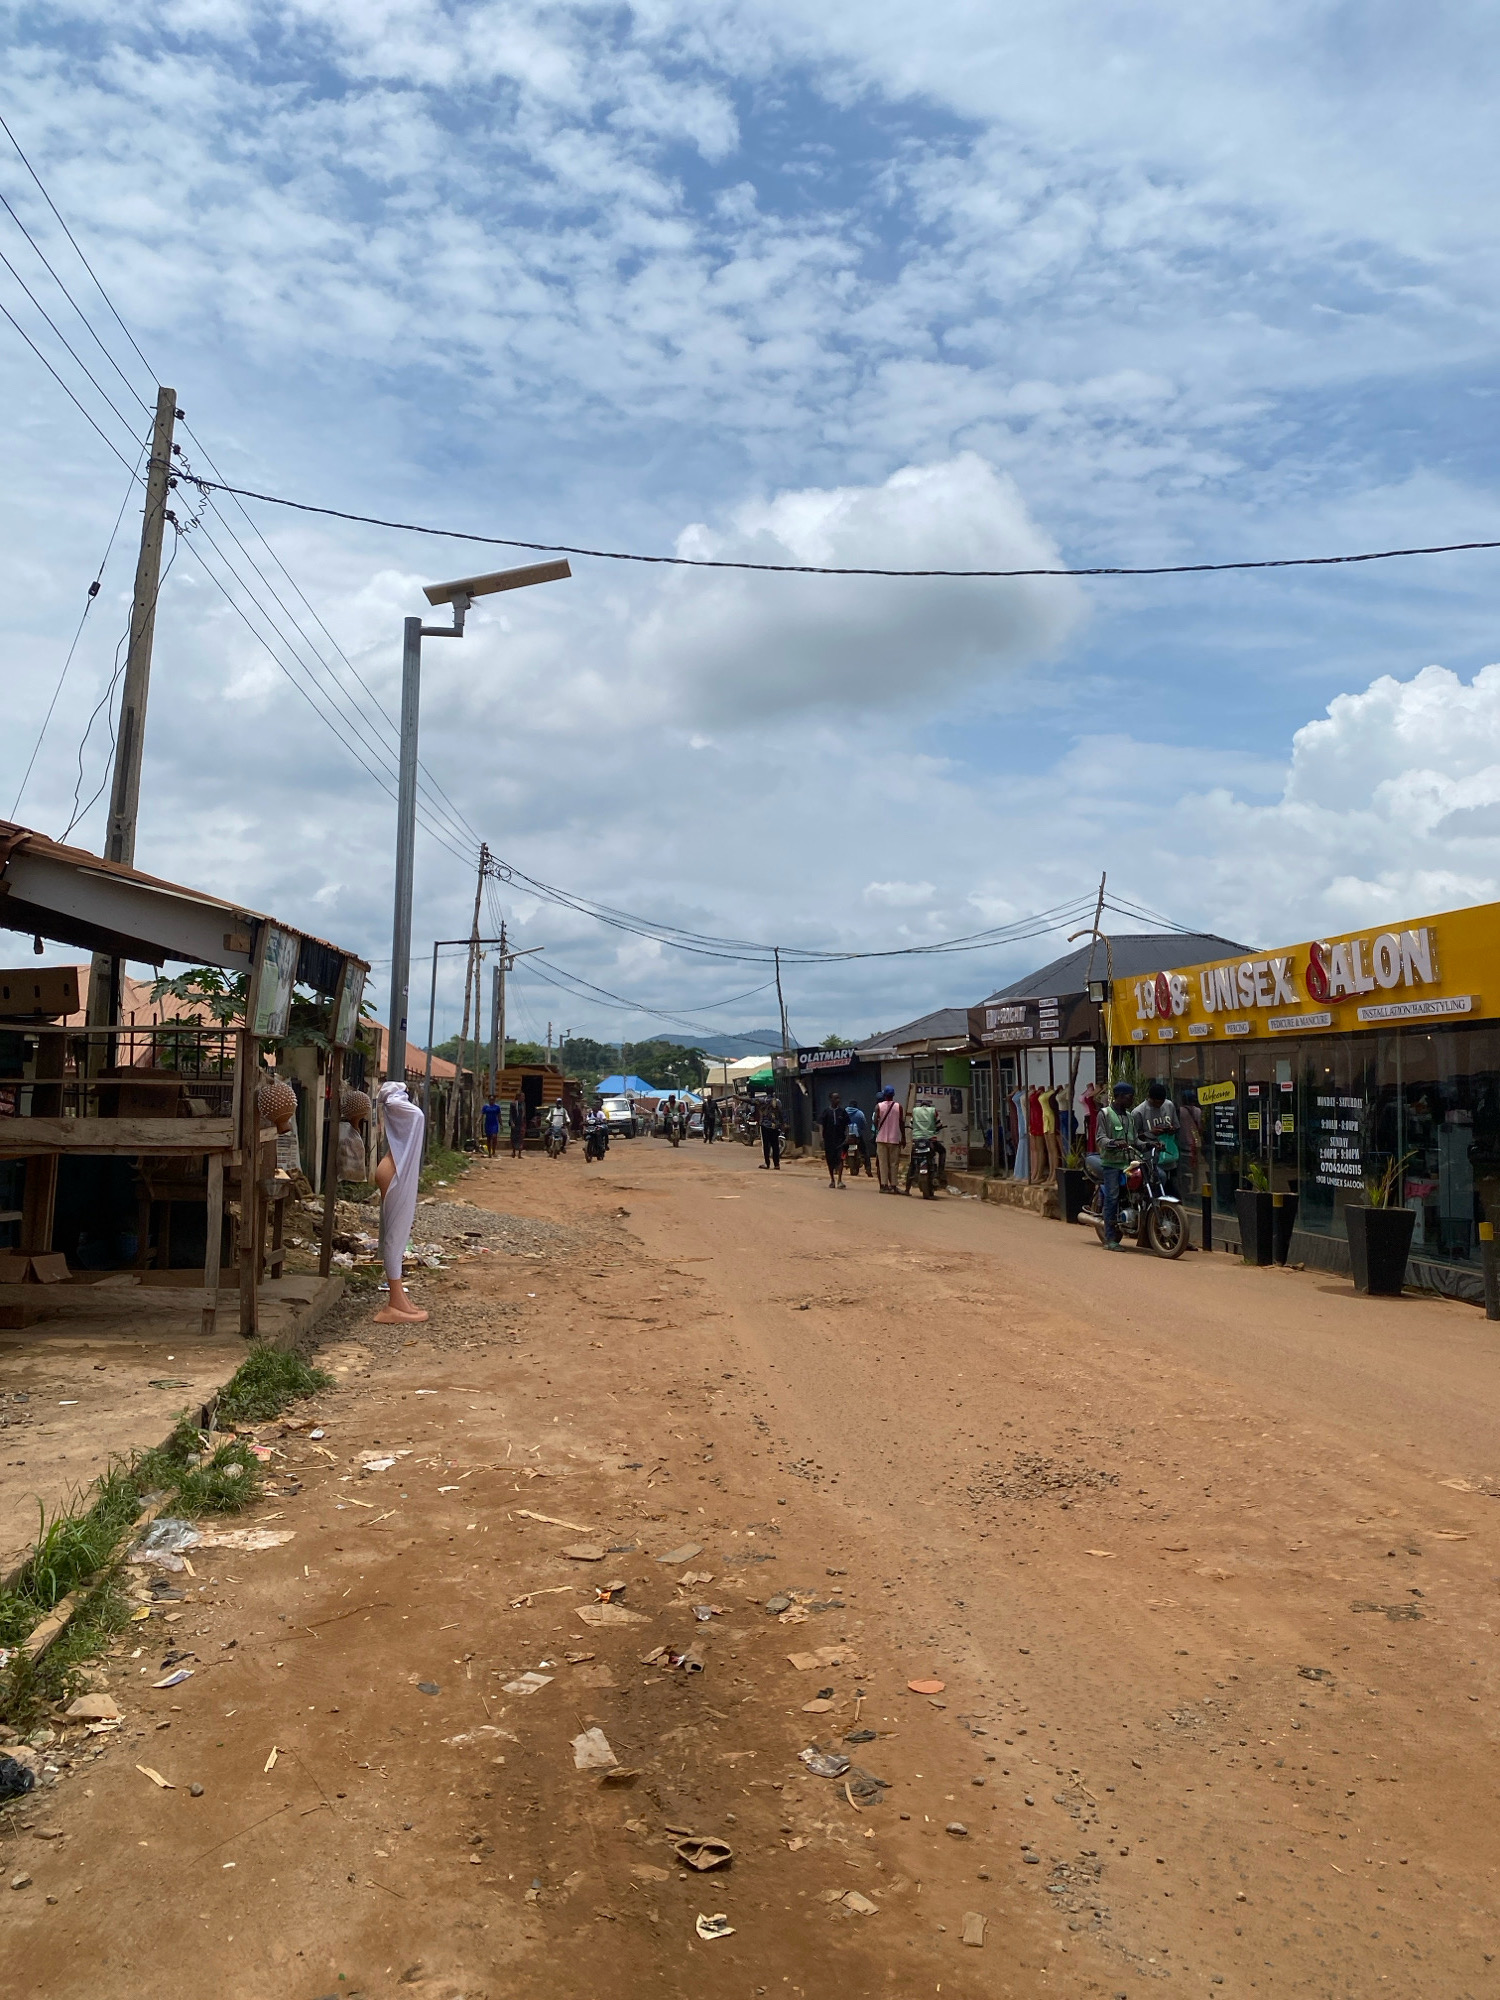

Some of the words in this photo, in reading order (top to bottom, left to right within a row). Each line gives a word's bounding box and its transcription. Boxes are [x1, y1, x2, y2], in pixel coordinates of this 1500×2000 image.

[1135, 971, 1187, 1020] 1908
[1200, 957, 1295, 1013] UNISEX
[1305, 928, 1434, 1005] SALON
[1227, 1024, 1247, 1034] PIERCING
[1271, 1019, 1294, 1030] PEDICURE
[1300, 1015, 1329, 1026] MANICURE
[800, 1048, 854, 1064] OLATMARY
[1203, 1088, 1231, 1102] Welcome
[1317, 1096, 1335, 1107] MONDAY
[1339, 1097, 1363, 1108] SATURDAY
[1330, 1137, 1348, 1147] SUNDAY
[1320, 1162, 1362, 1175] 07042405115
[1327, 1177, 1343, 1187] UNISEX
[1344, 1179, 1365, 1189] SALOON
